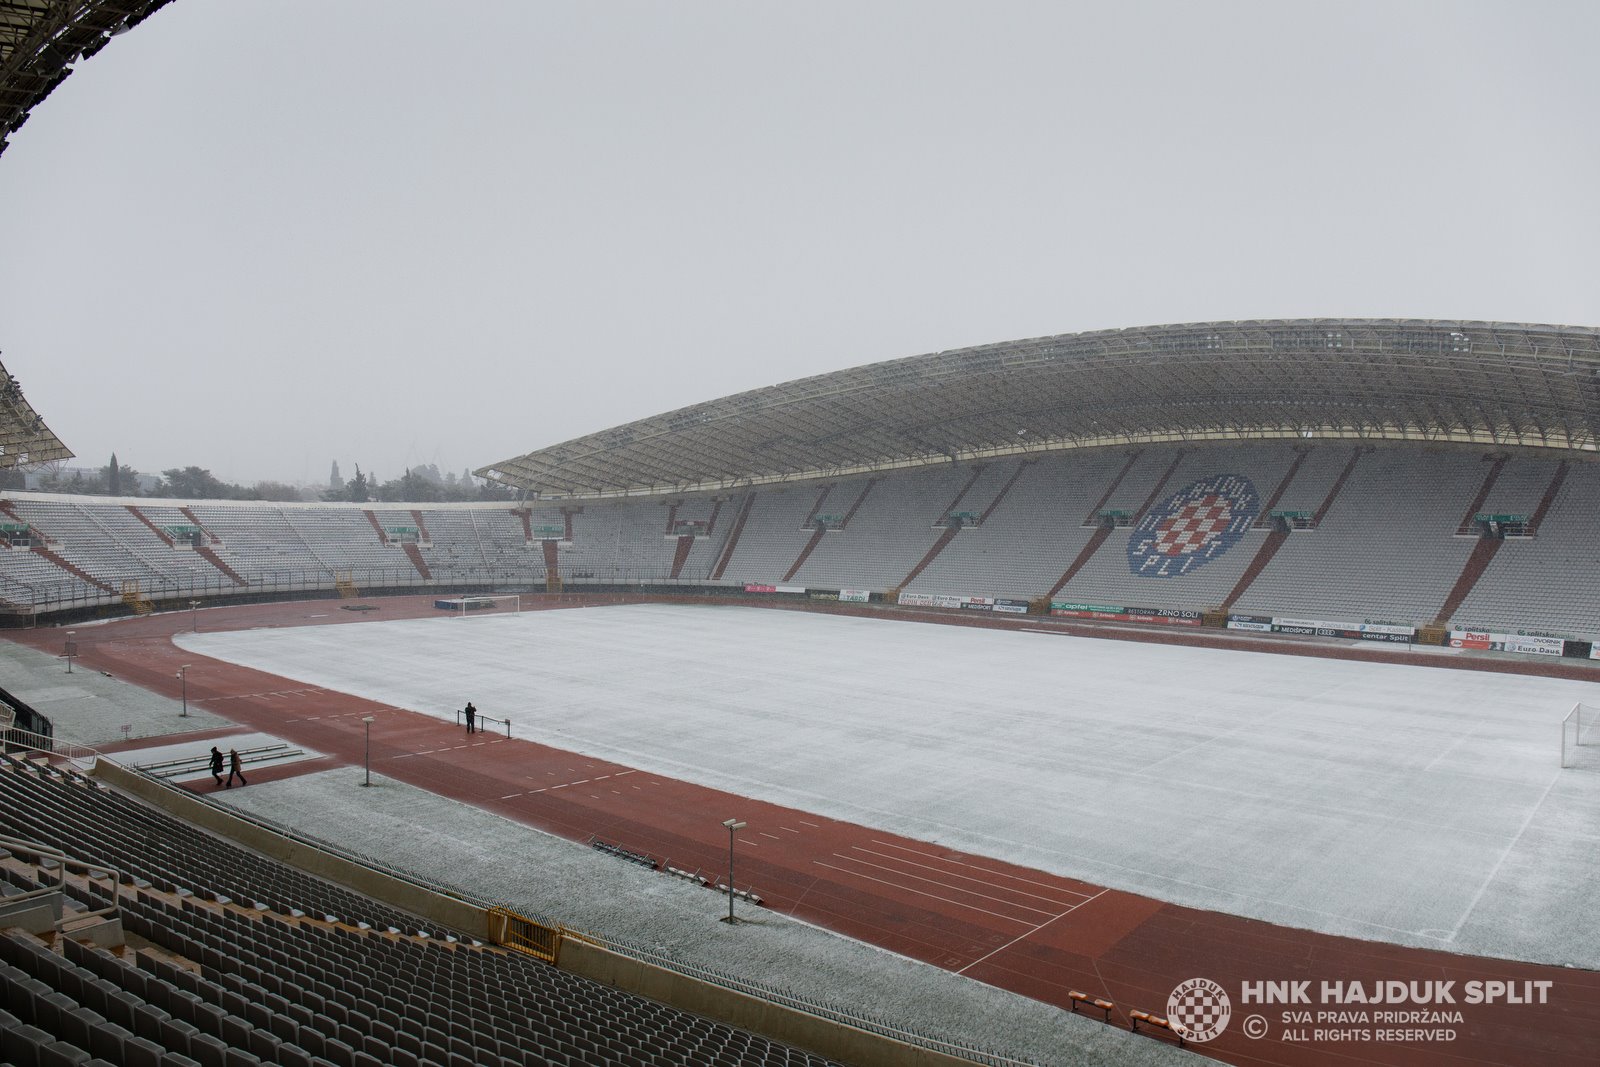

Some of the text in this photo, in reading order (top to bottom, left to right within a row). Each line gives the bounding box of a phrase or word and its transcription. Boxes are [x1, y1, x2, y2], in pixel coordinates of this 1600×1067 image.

[1132, 539, 1222, 575] SPLIT
[1157, 609, 1179, 617] ZRNO
[1181, 610, 1198, 618] SOLI
[1465, 633, 1490, 641] Persil
[1517, 645, 1560, 655] Euro Daus
